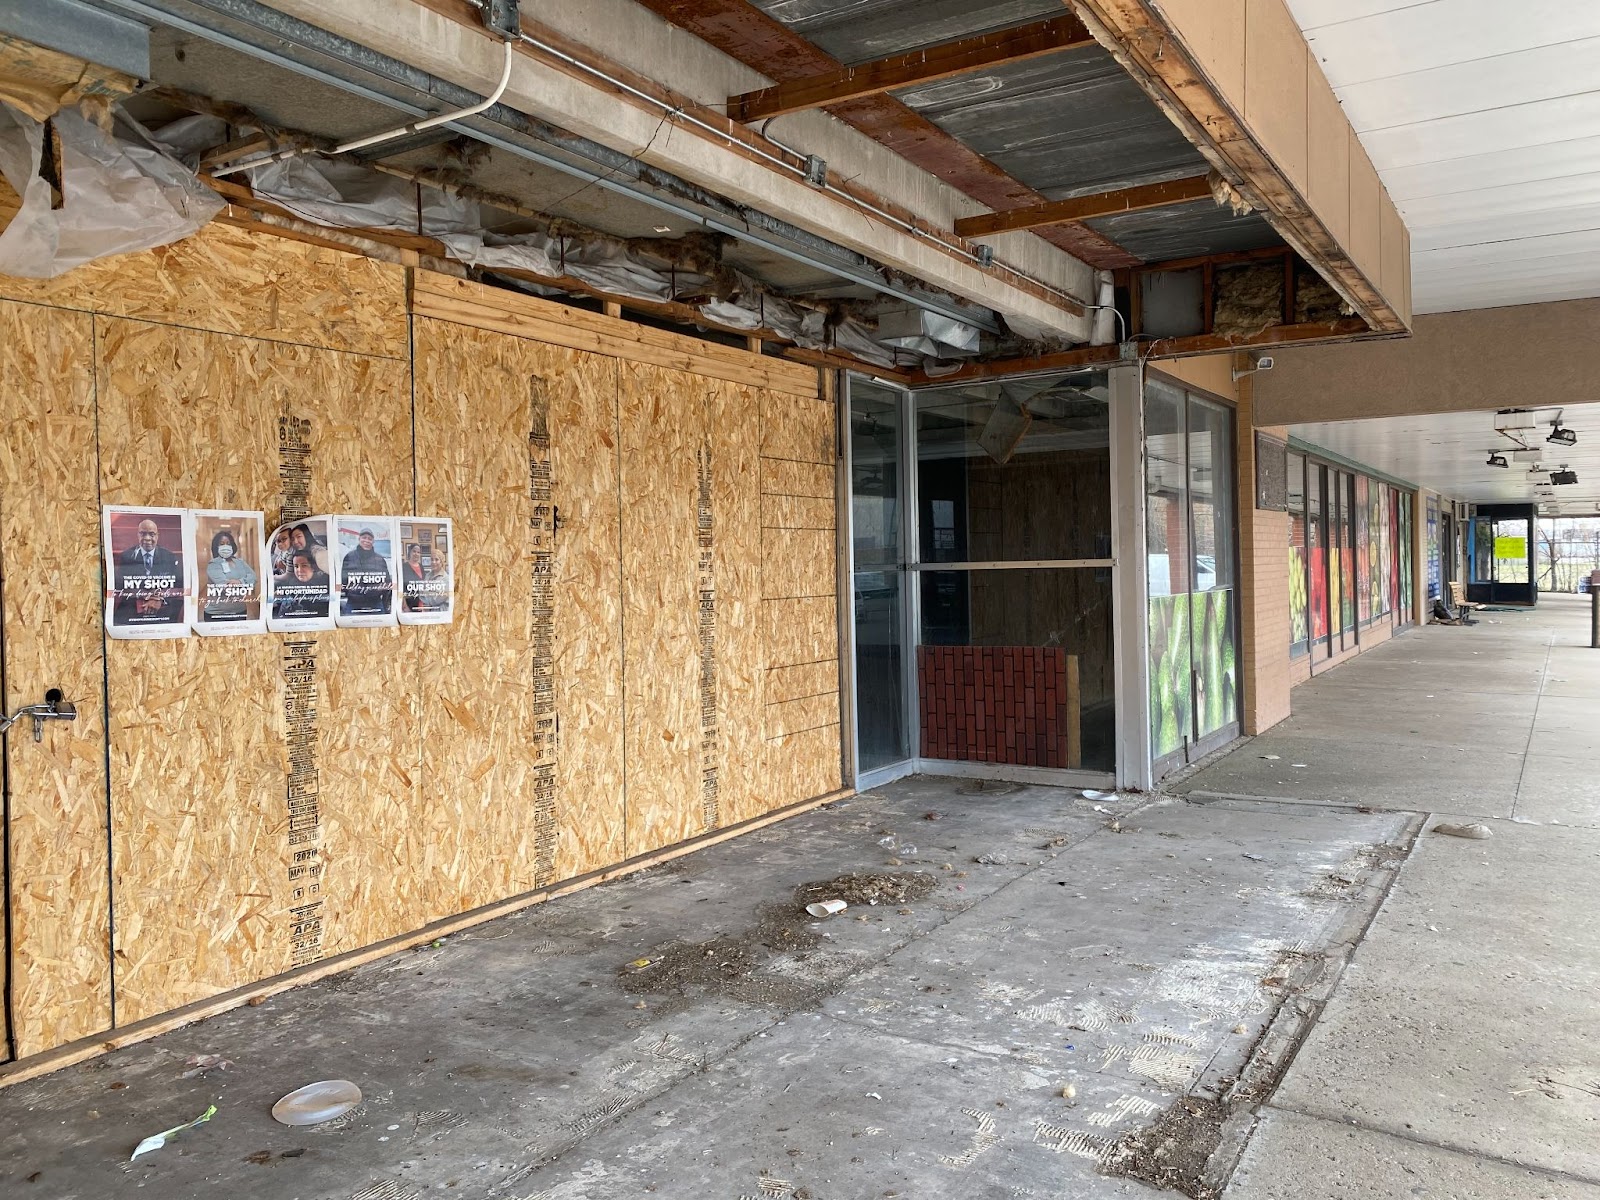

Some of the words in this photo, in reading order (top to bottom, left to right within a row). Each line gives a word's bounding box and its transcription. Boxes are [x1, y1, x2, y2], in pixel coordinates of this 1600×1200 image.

[124, 580, 142, 589] MY
[144, 579, 176, 589] SHOT
[363, 575, 387, 583] SHOT
[207, 588, 223, 596] MY
[225, 587, 254, 596] SHOT
[425, 583, 446, 591] SHOT
[287, 660, 315, 669] APA
[537, 778, 554, 788] APA
[705, 780, 717, 788] APA
[296, 849, 317, 861] 2020
[290, 867, 304, 878] MAY
[294, 921, 320, 935] APA
[295, 937, 318, 949] 32/16
